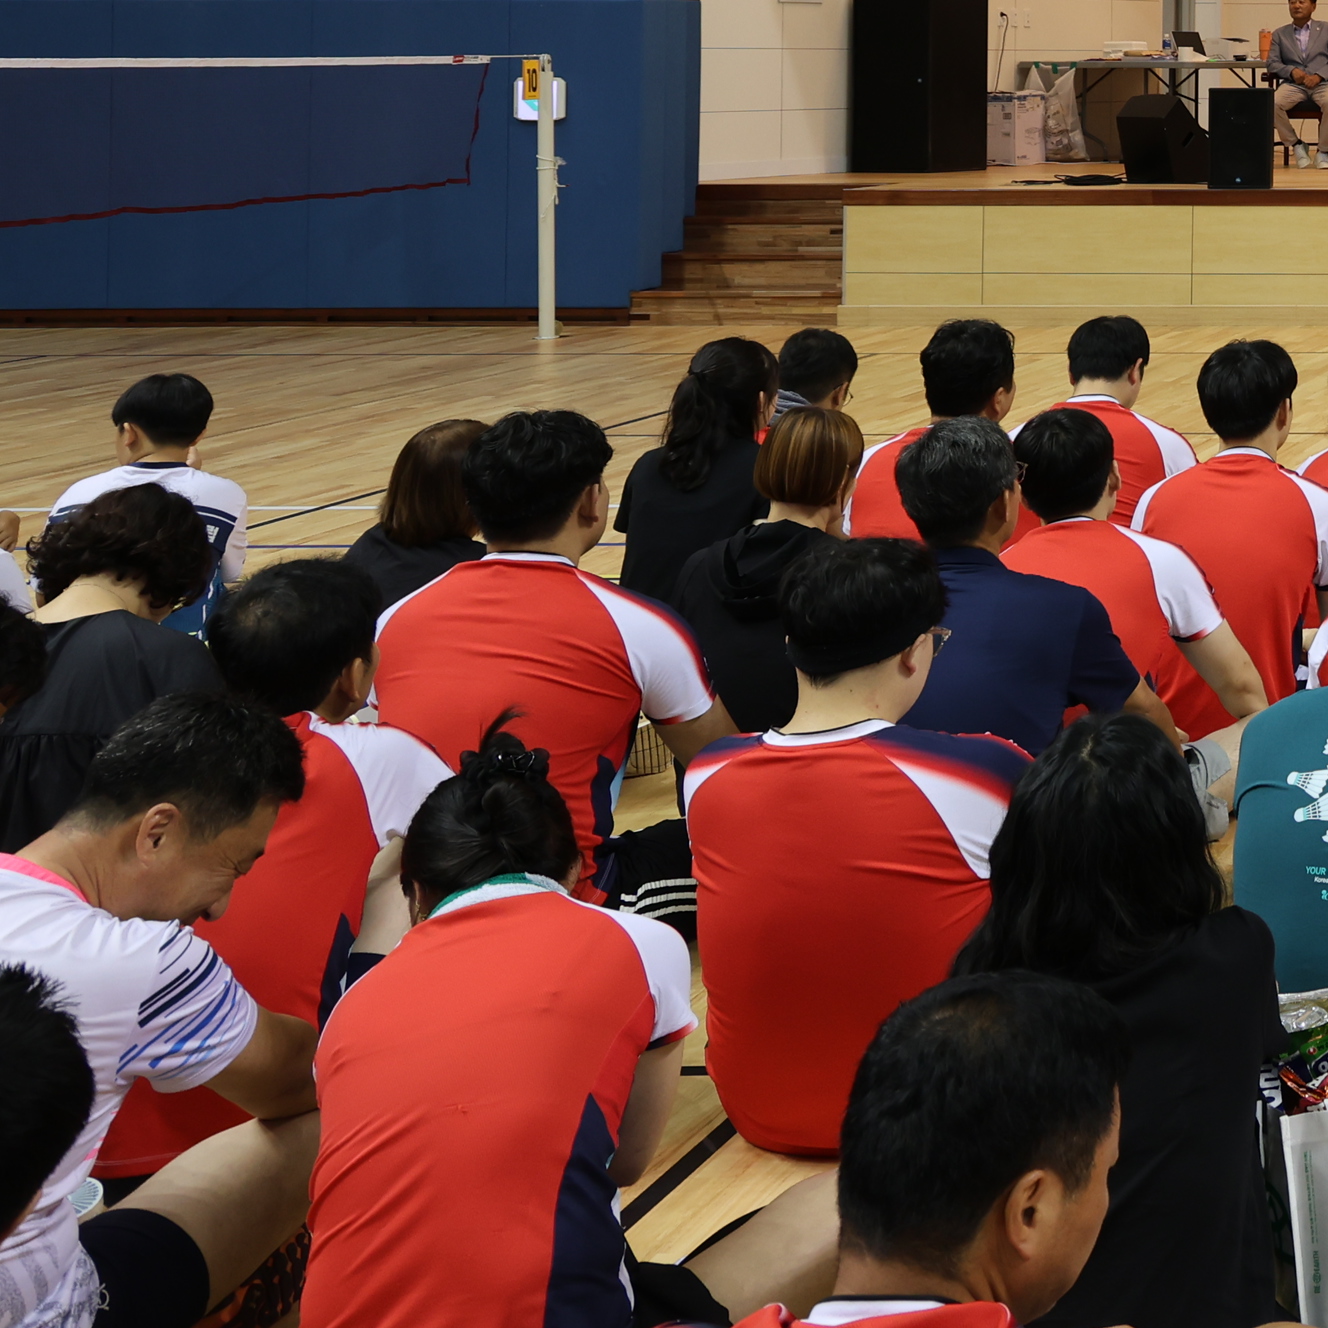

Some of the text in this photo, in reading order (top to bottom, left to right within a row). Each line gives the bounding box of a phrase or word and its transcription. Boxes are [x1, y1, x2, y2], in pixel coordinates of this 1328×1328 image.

[526, 68, 538, 93] 10
[1305, 866, 1326, 876] YOUR
[1314, 876, 1328, 884] Korea
